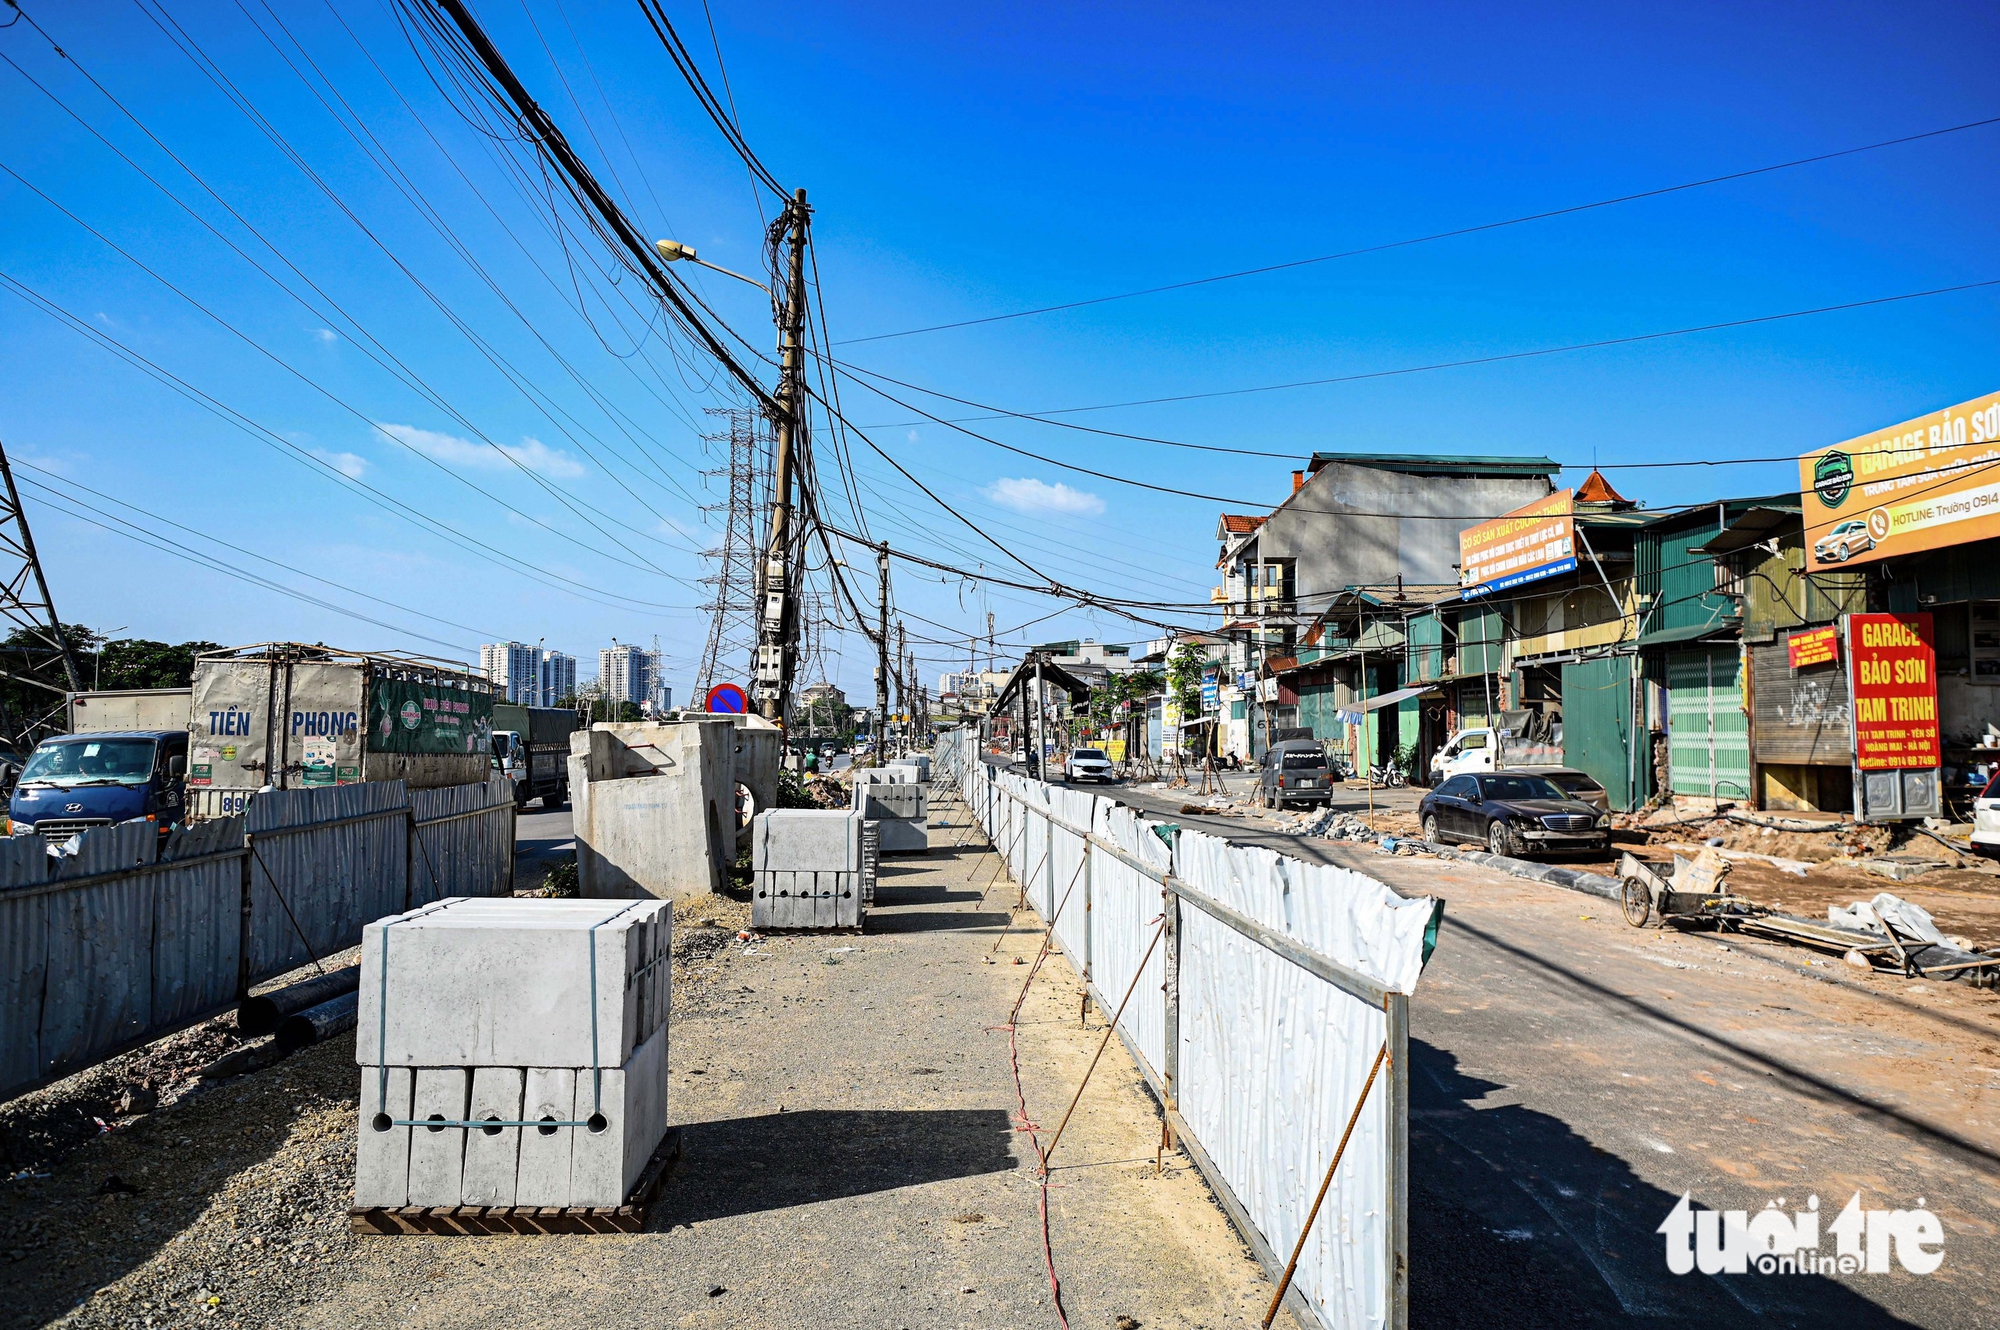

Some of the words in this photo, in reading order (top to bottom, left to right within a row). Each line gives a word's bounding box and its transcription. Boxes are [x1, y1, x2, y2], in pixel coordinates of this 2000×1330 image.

[1861, 429, 1925, 475] GARAGE
[1929, 410, 1966, 456] BẢO
[1971, 402, 2000, 443] SƠ
[1815, 478, 1833, 488] GARAGE
[1862, 479, 1894, 497] TRUNG
[1896, 474, 1917, 489] TÂM
[1893, 508, 1935, 526] HOTLINE:
[1936, 501, 1970, 517] Trường
[1973, 492, 1999, 508] 0914
[1463, 534, 1473, 550] CƠ
[1473, 529, 1482, 546] SỞ
[1482, 524, 1495, 542] SẢN
[1496, 519, 1514, 538] XUẤT
[1515, 510, 1542, 532] CƯỜNG
[1543, 499, 1567, 521] THỊNH
[1860, 652, 1891, 685] BẢO
[1895, 657, 1926, 684] SƠN
[209, 704, 250, 736] TIỀN
[292, 712, 357, 736] PHONG
[1855, 697, 1887, 722] TAM
[1889, 696, 1935, 721] TRINH
[1857, 730, 1869, 740] 711
[1871, 729, 1885, 739] TAM
[1886, 729, 1906, 739] TRINH
[1911, 727, 1925, 738] YÊN
[1926, 725, 1936, 738] SỞ
[1865, 740, 1888, 752] HOÀNG
[1889, 742, 1903, 751] MAI
[1908, 740, 1918, 751] HÀ
[1918, 739, 1931, 752] NỘI
[1859, 757, 1887, 768] Hotline:
[1888, 756, 1906, 766] 0914
